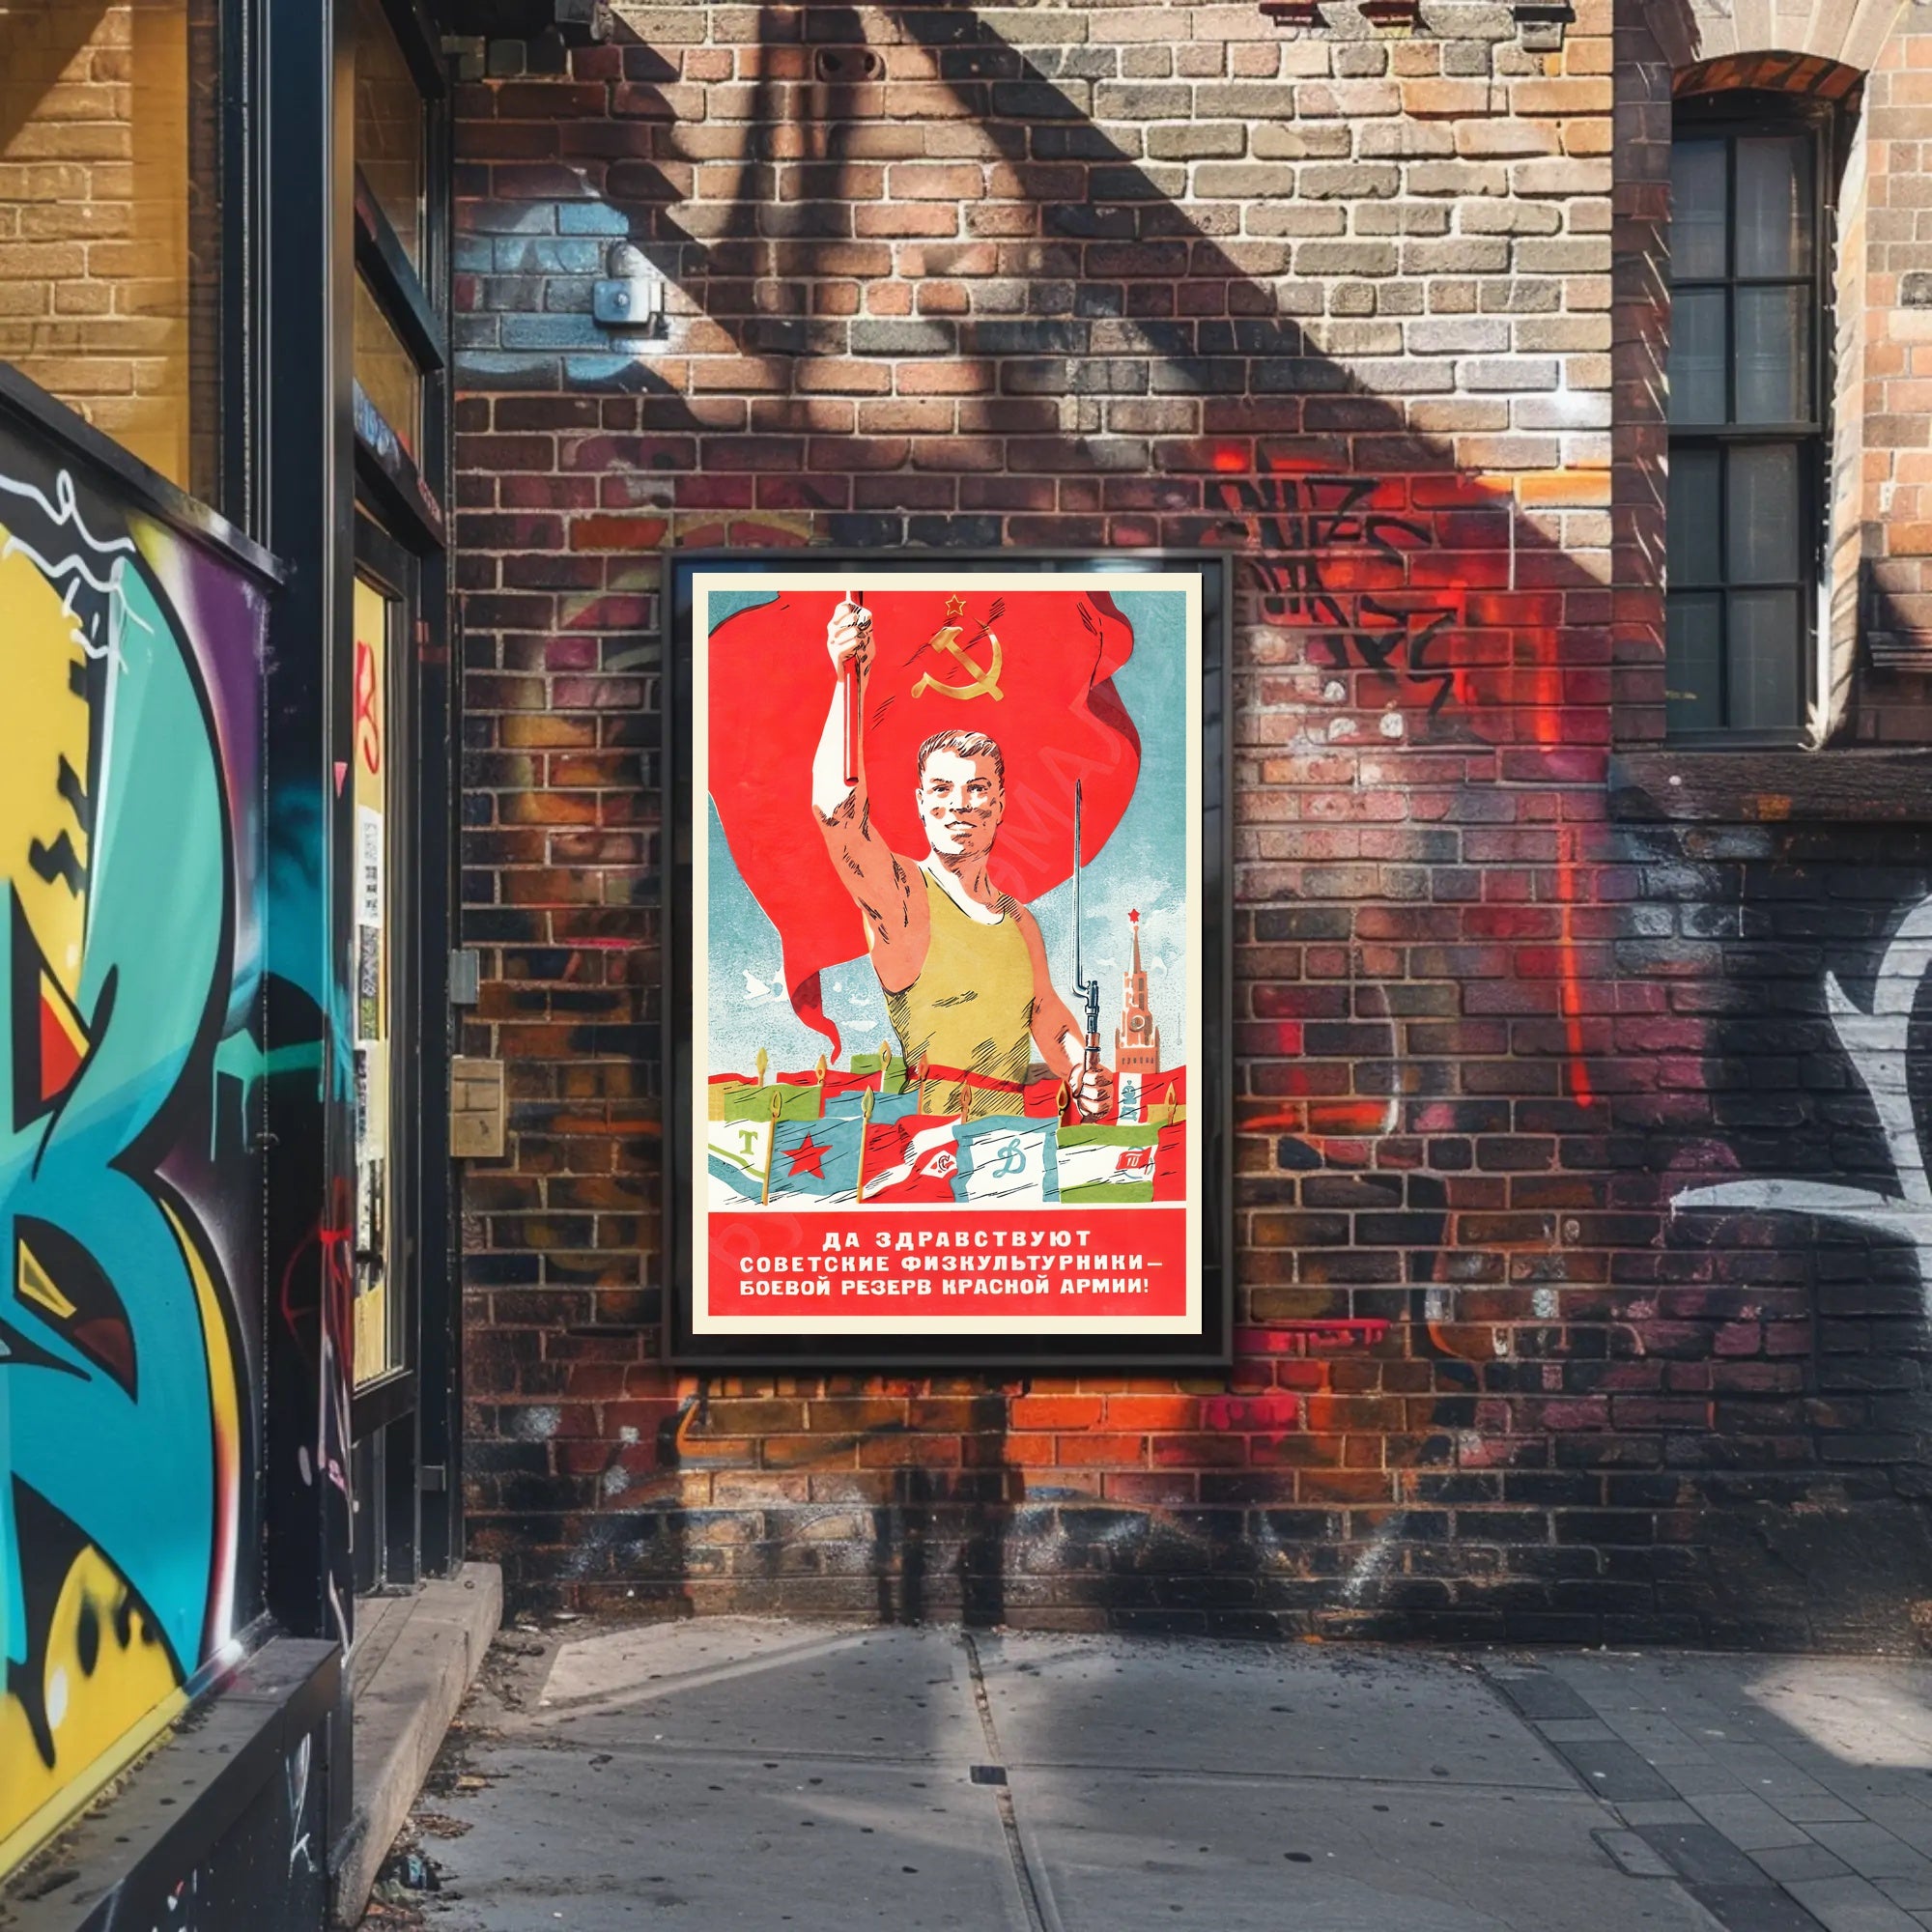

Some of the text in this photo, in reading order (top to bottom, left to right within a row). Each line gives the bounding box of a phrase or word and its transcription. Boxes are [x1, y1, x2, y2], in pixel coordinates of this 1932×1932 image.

[822, 1232, 860, 1251] ДА
[875, 1230, 1091, 1252] ЗДРАВСТВУЮТ
[739, 1256, 890, 1273] СОВЕТСКИЕ
[740, 1273, 1149, 1295] БОЕВОЙ РЕЗЕРВ КРАСНОЙ АРМИИ!
